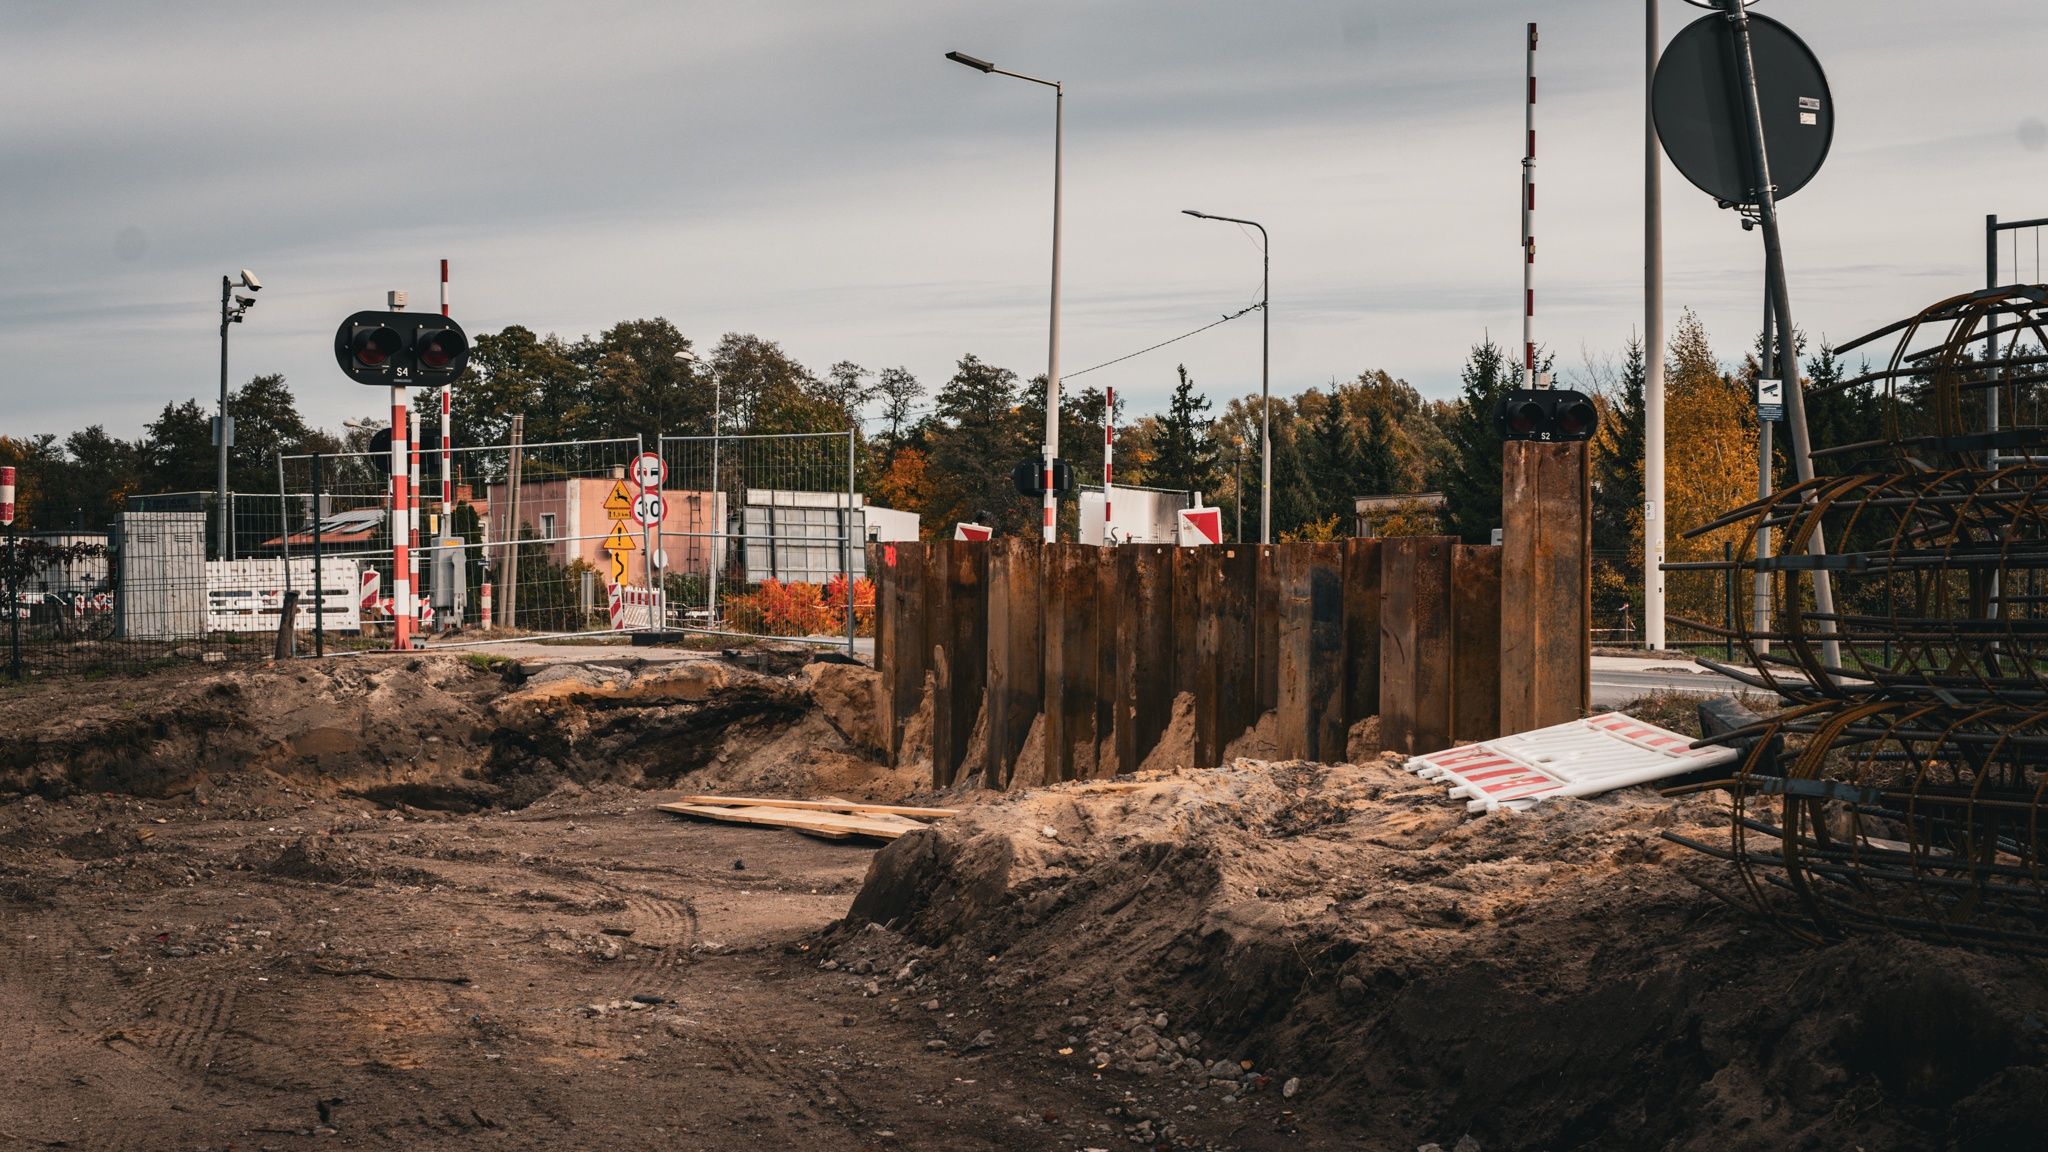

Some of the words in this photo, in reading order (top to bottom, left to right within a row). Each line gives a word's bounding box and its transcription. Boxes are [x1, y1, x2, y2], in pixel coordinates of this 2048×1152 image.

[396, 367, 409, 377] S4
[1541, 432, 1551, 440] S2
[637, 500, 660, 517] 30
